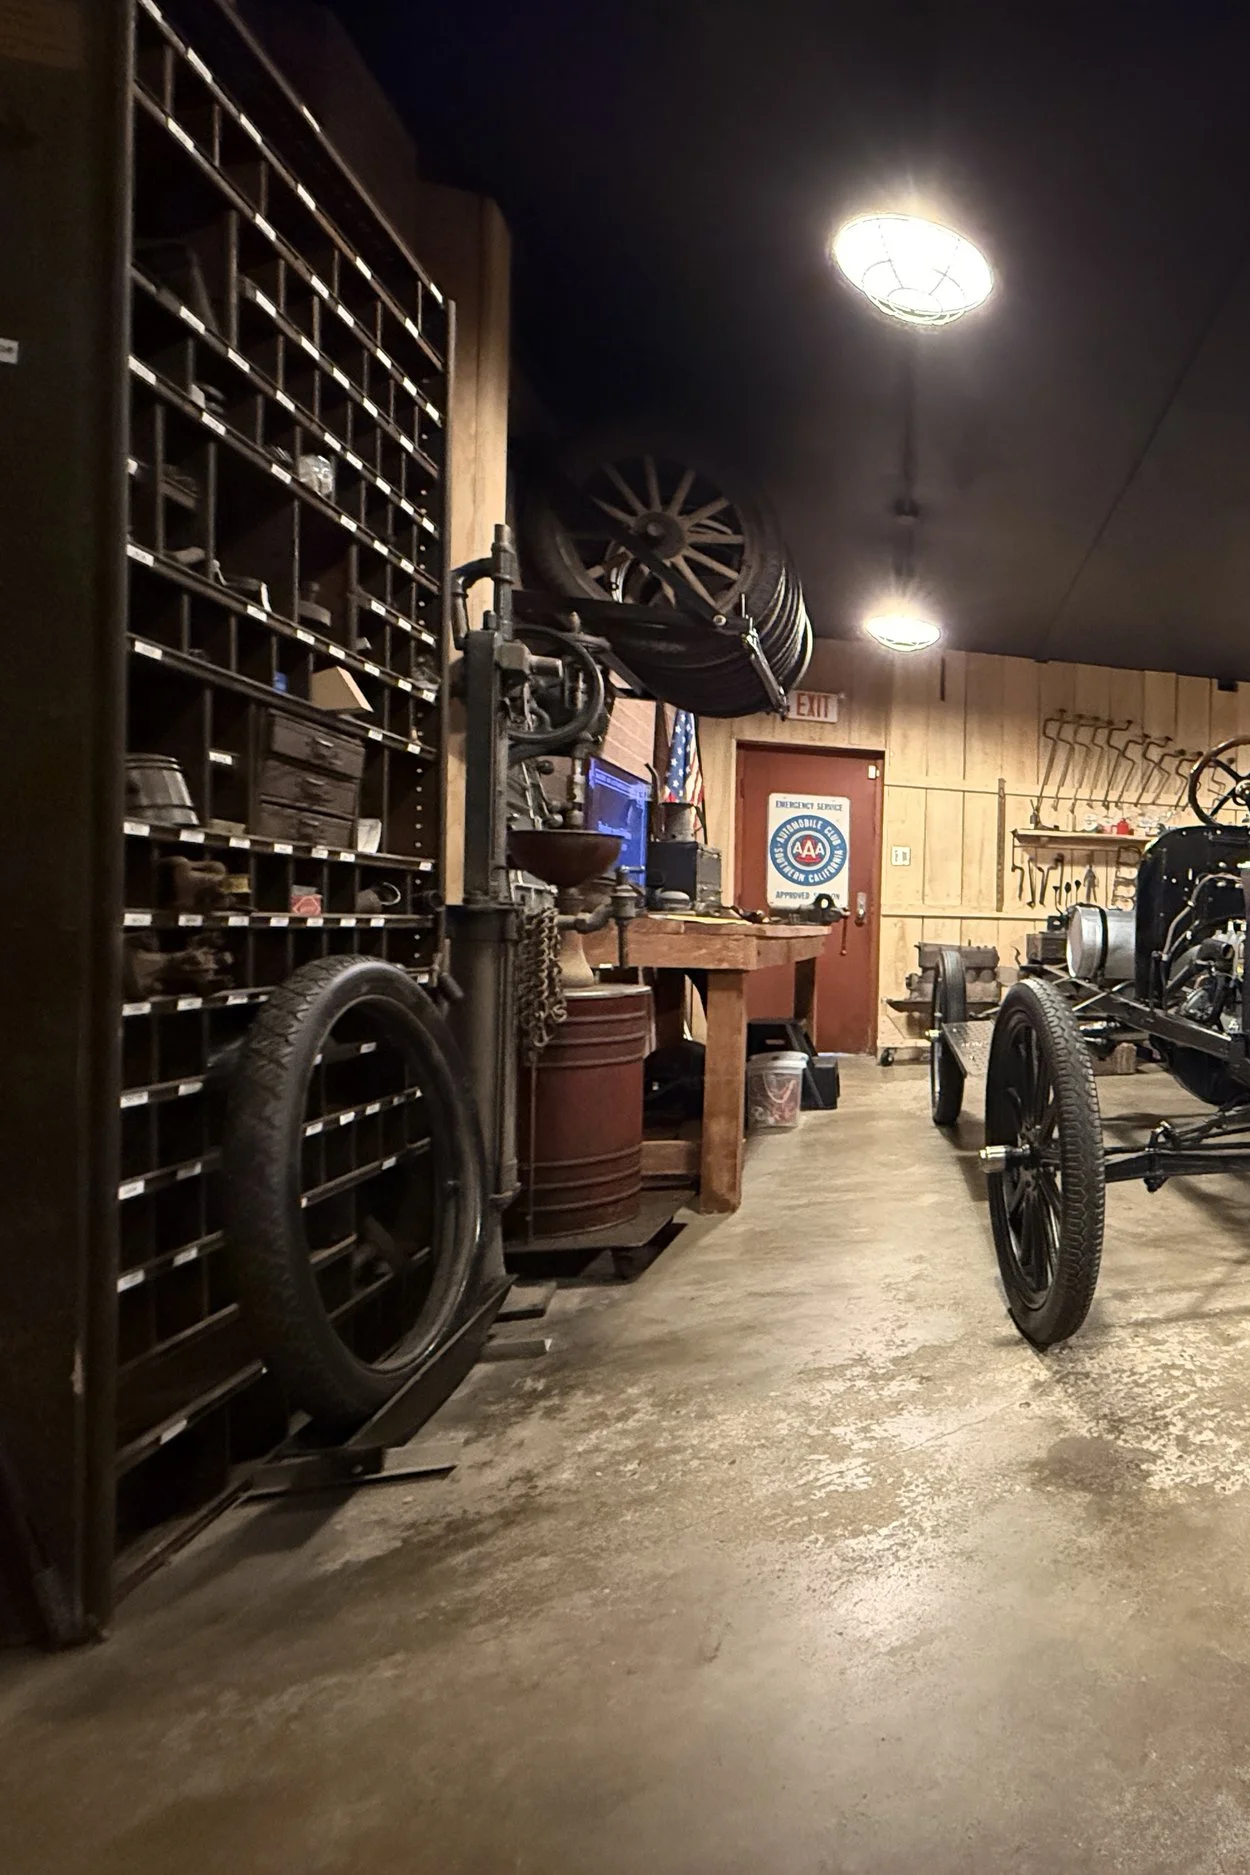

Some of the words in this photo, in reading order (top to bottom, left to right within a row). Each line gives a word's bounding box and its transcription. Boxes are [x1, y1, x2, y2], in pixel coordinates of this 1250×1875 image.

[797, 692, 828, 718] EXIT
[776, 800, 814, 811] EMERGENCY
[817, 802, 843, 812] SERVICE
[776, 818, 823, 842] AUTOMOBILE
[824, 826, 842, 846] CLUB
[793, 840, 825, 859] AAA
[774, 847, 805, 882] SOUTHERN
[808, 848, 844, 883] CALIFORNIA
[776, 890, 810, 900] APPROVED
